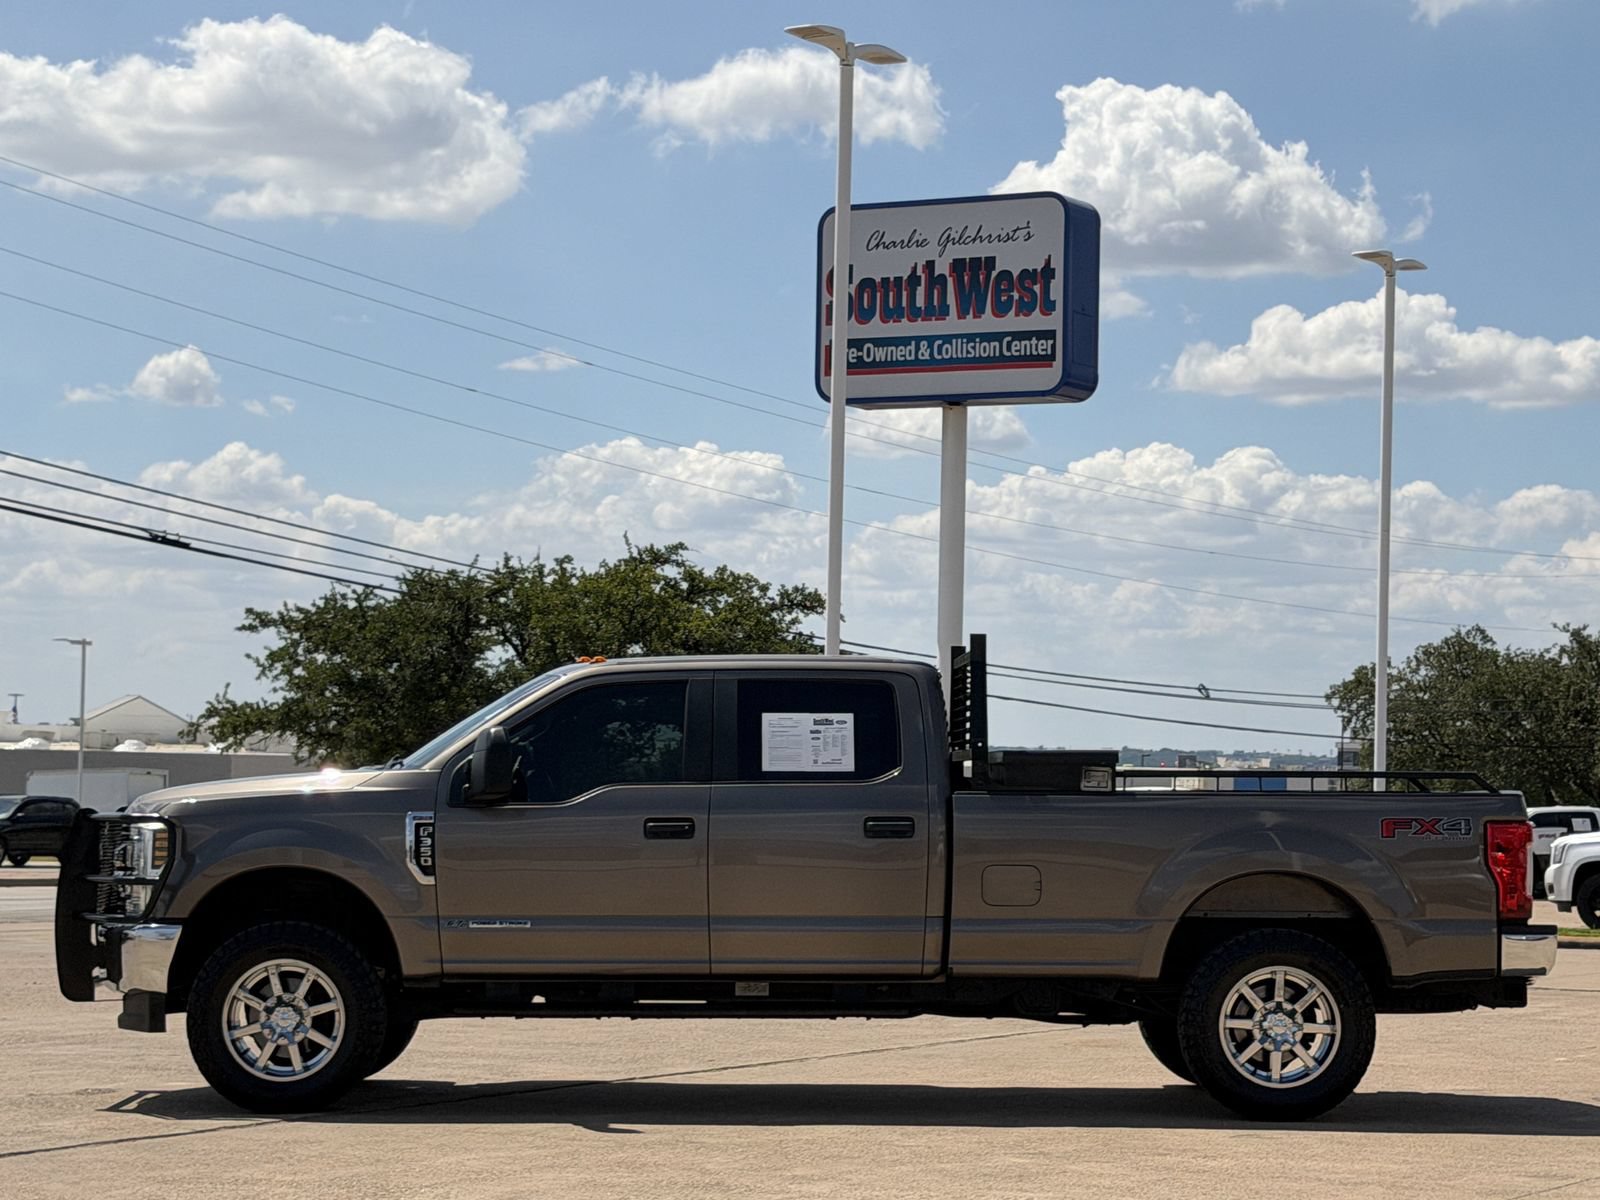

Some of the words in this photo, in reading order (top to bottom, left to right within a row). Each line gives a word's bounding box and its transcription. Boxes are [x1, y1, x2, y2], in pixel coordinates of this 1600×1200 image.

[866, 228, 930, 252] Charlie
[937, 220, 1035, 258] Gilchrist's
[846, 340, 915, 363] e-Owned
[918, 340, 931, 360] &
[933, 338, 1000, 360] Collision
[1002, 336, 1054, 357] Center
[1380, 817, 1472, 839] FX4
